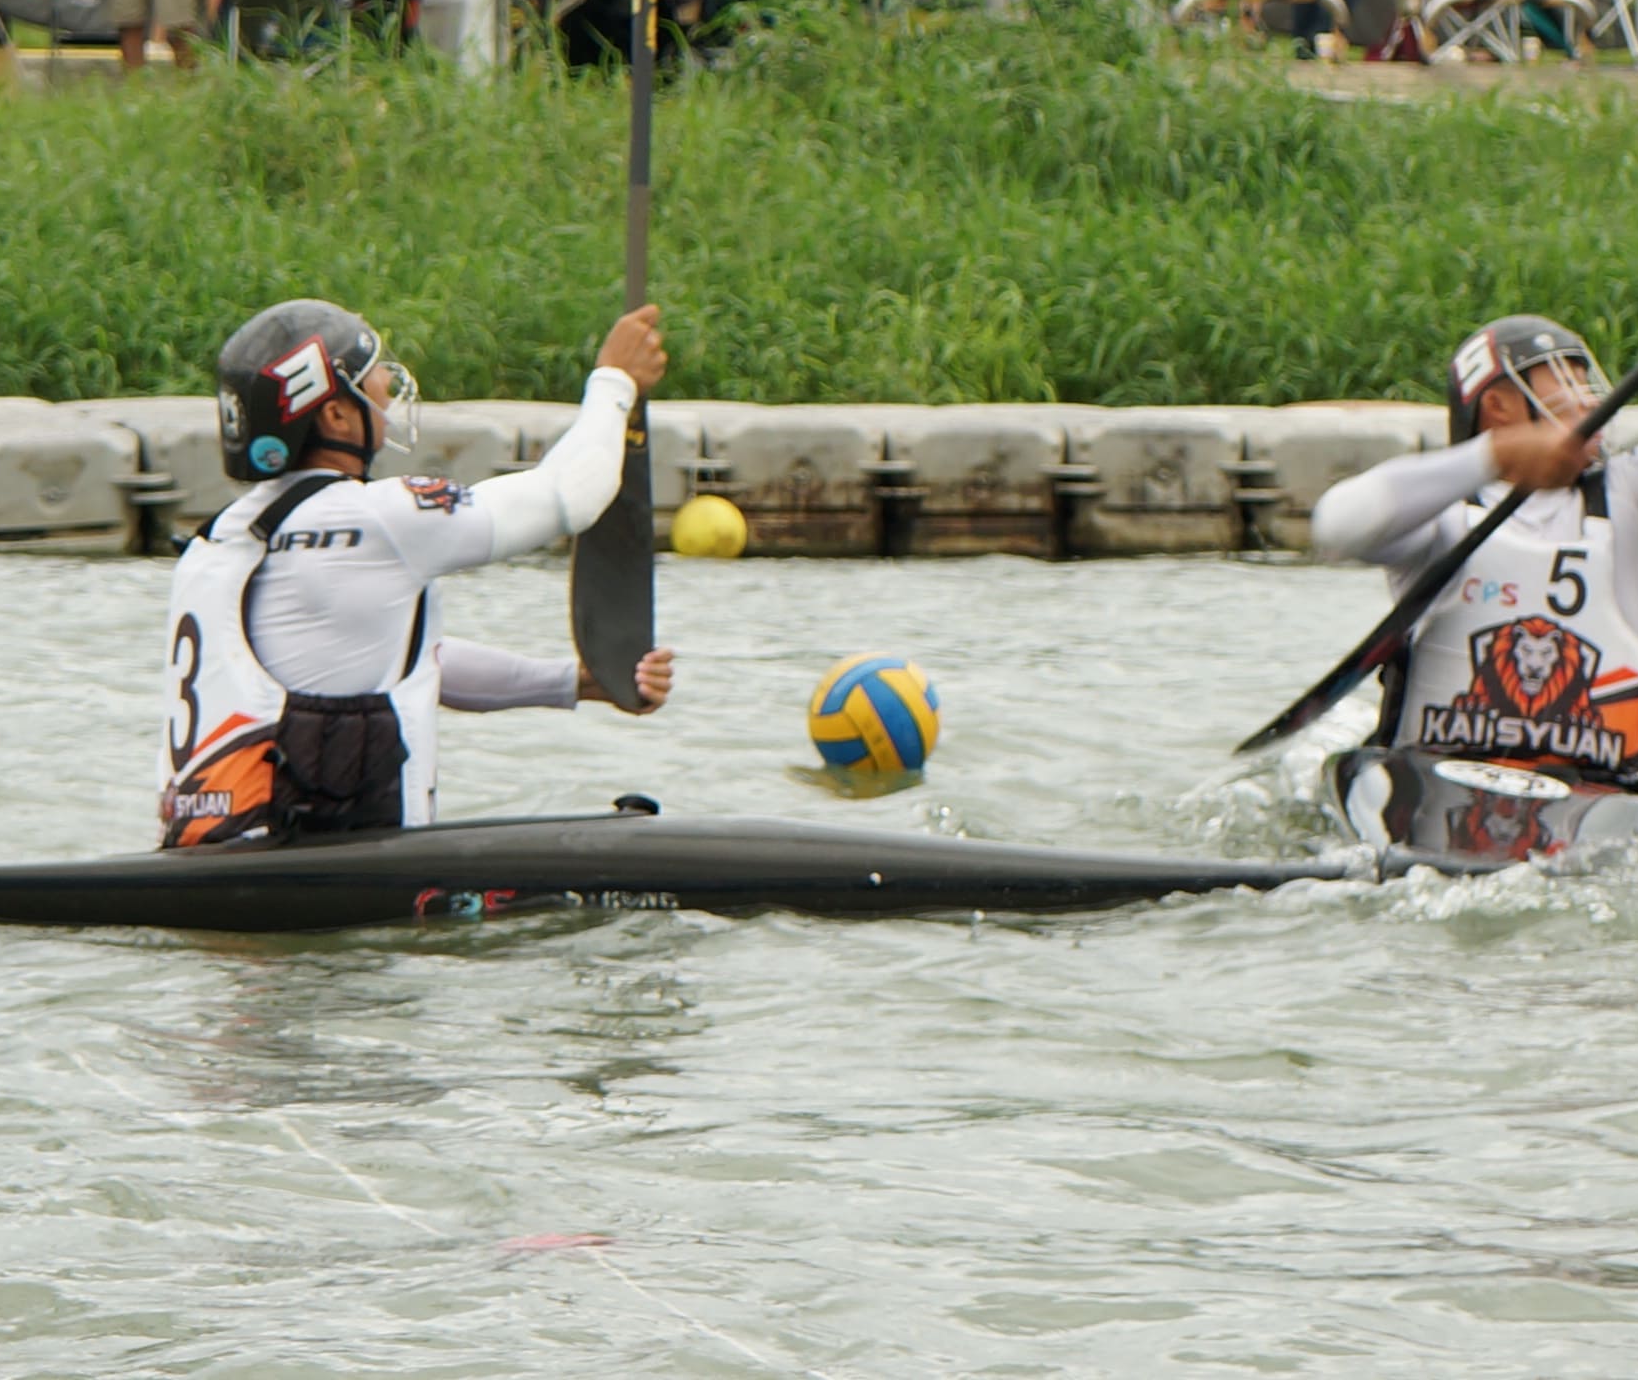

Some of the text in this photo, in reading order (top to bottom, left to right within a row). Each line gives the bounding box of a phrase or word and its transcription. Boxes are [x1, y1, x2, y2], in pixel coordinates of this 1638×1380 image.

[267, 338, 334, 419] 3
[1454, 331, 1496, 398] 5
[1462, 577, 1519, 607] CPS
[1547, 549, 1587, 616] 5
[169, 611, 201, 774] 3
